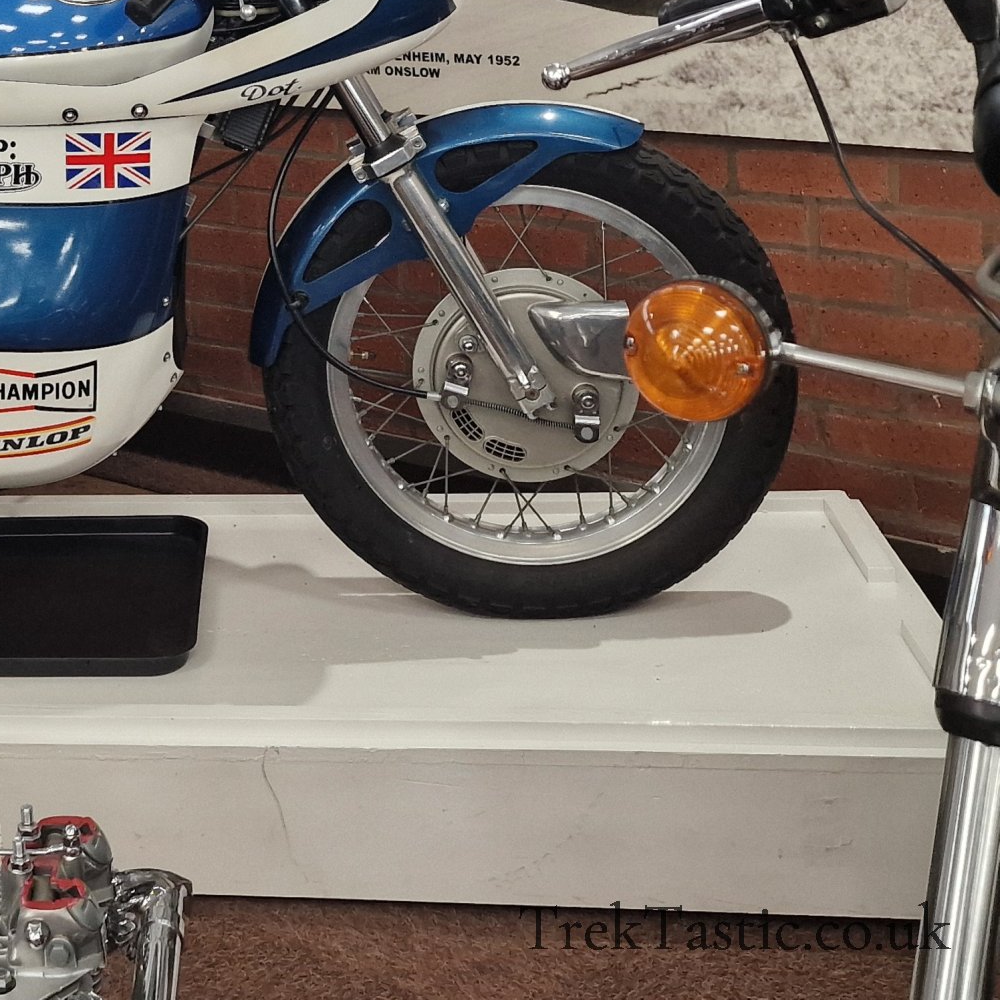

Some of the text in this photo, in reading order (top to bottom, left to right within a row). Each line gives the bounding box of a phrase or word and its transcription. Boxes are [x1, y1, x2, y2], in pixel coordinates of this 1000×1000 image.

[395, 51, 521, 67] NHEIM, MAY 1952
[384, 65, 441, 79] ONSLOW
